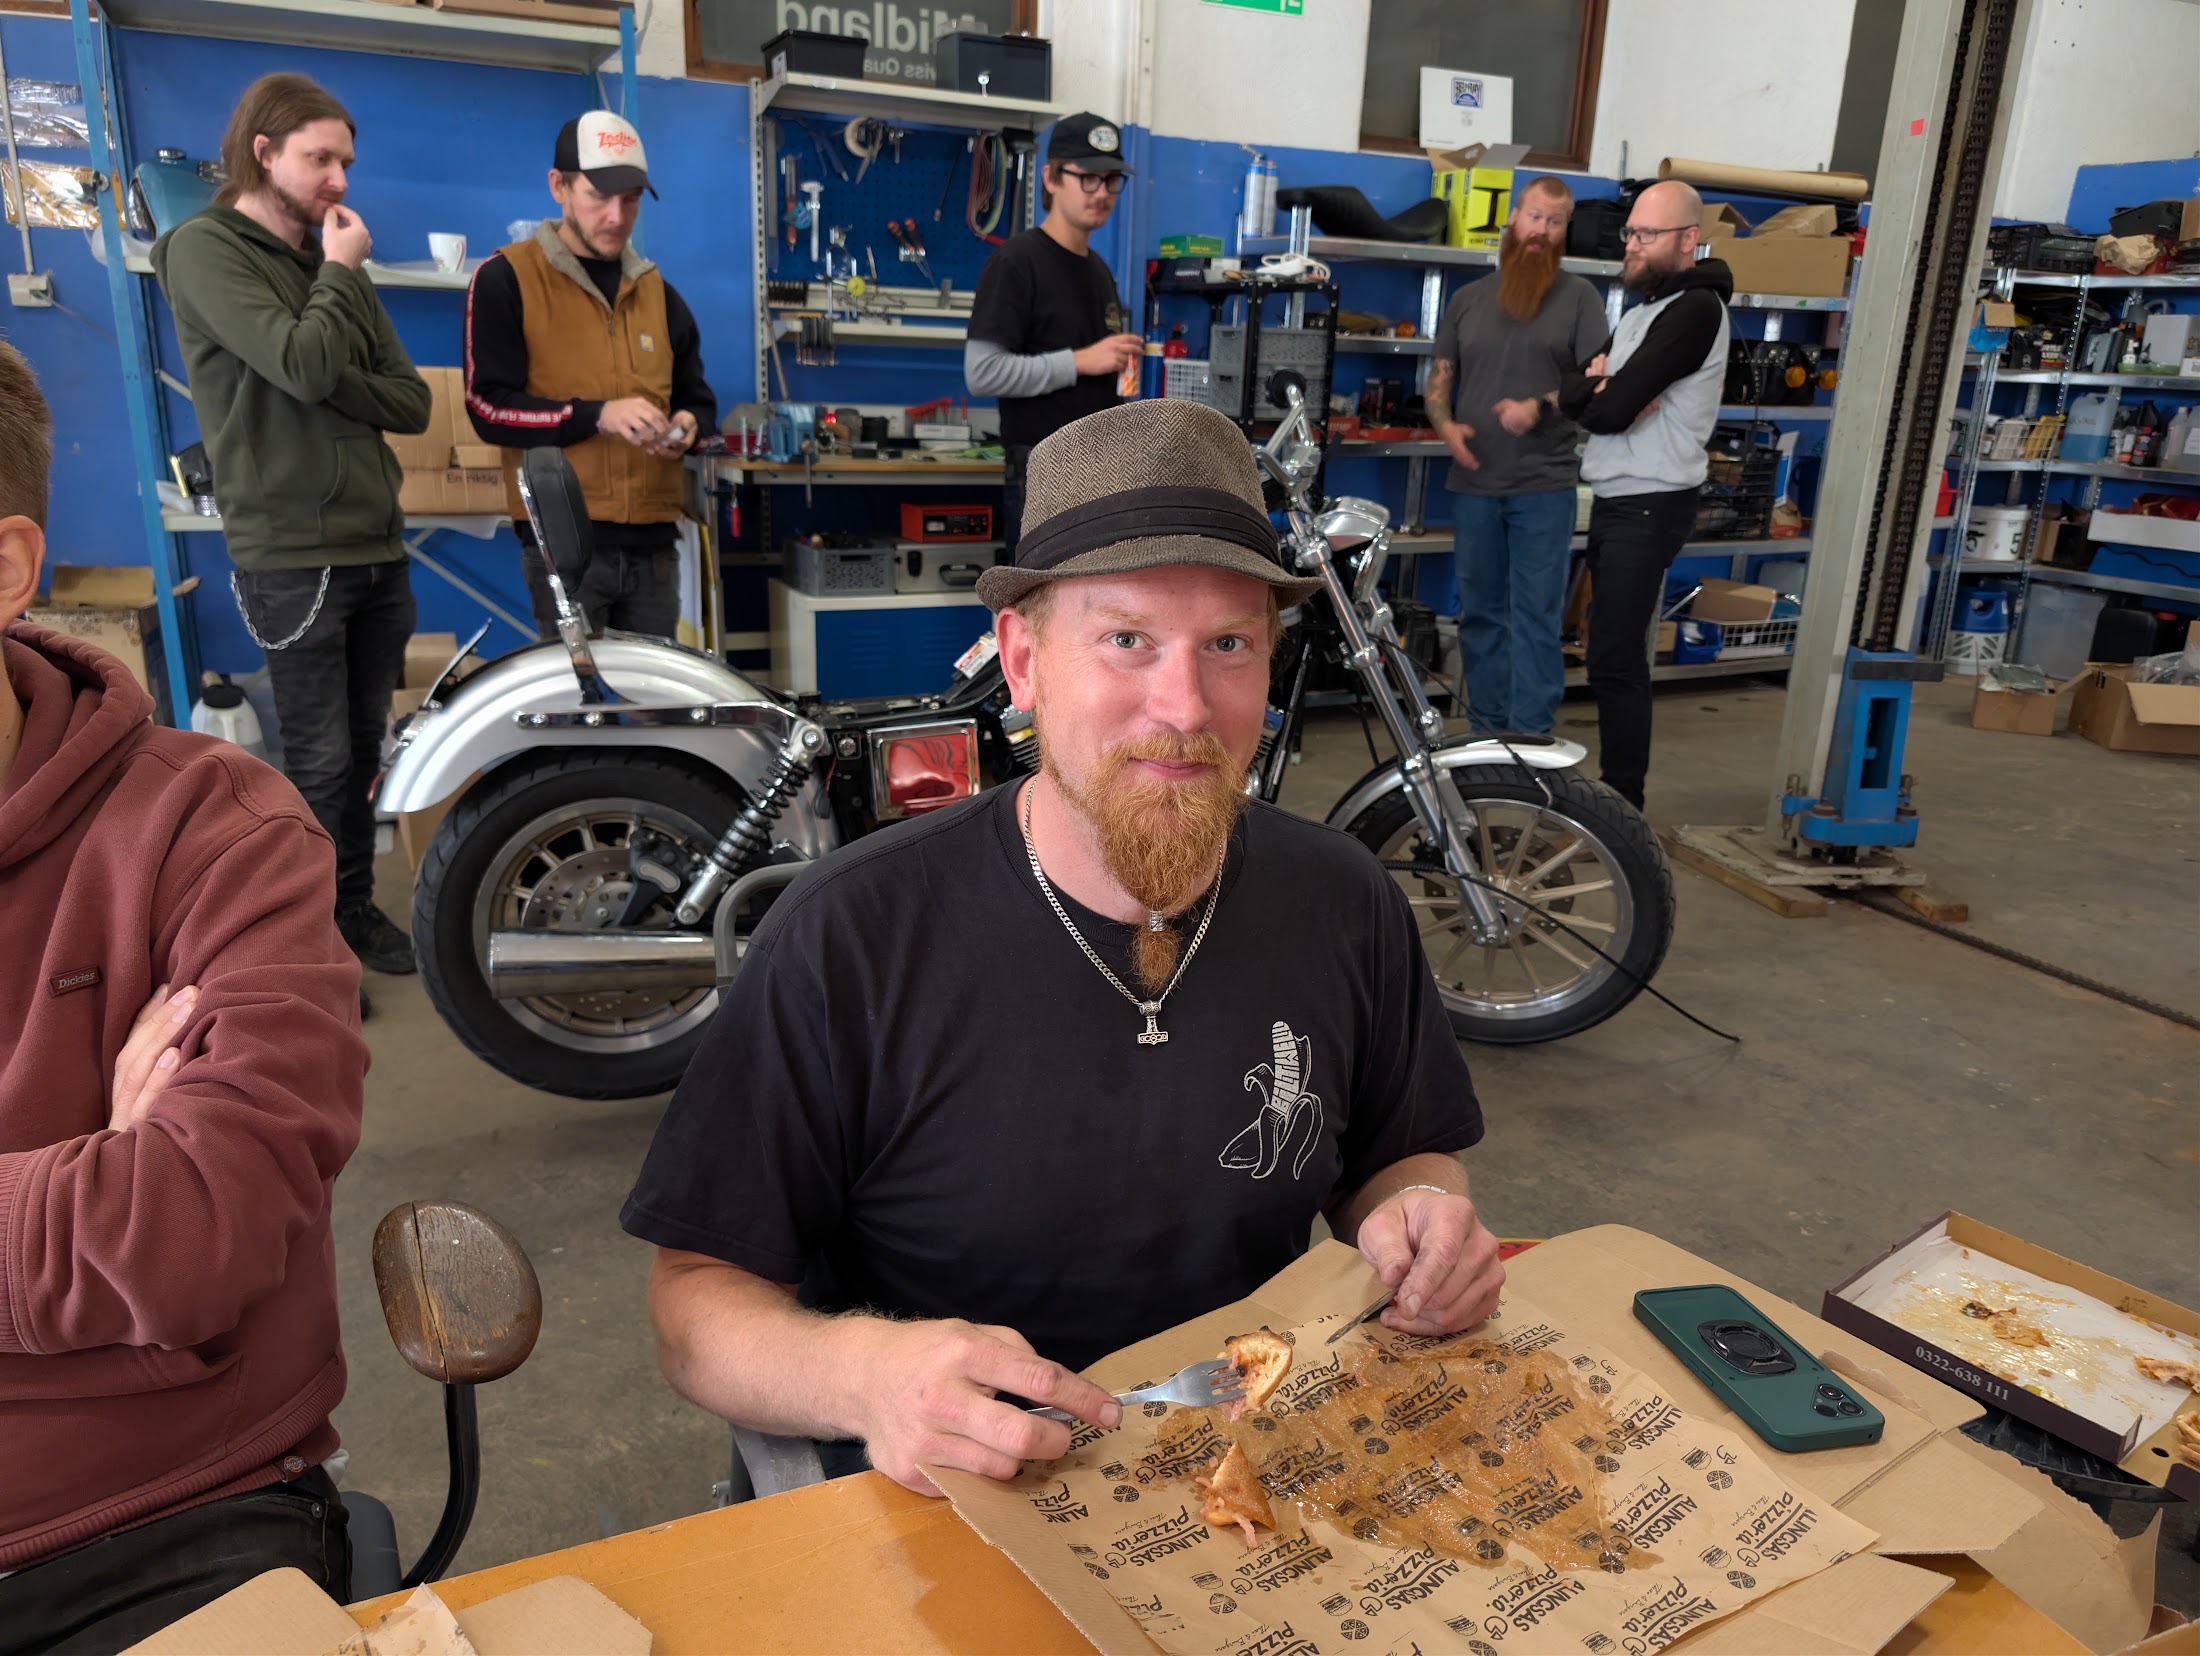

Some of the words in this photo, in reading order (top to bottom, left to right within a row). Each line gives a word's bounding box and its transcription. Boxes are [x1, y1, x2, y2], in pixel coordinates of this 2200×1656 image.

[58, 972, 95, 989] Dickies
[1276, 1351, 1340, 1399] pizzeria
[1915, 1346, 1982, 1387] 0322-638
[1985, 1381, 2009, 1401] 111
[1141, 1415, 1214, 1465] pizzeria
[1606, 1395, 1663, 1439] pizzeria
[1111, 1504, 1190, 1551] pizzeria
[1610, 1475, 1671, 1533] pizzeria
[1633, 1496, 1698, 1549] ALINGSÅS
[1736, 1491, 1793, 1545] pizzeria
[1129, 1526, 1210, 1567] ALINGSÅS
[1235, 1527, 1311, 1577] pizzeria
[1256, 1547, 1334, 1592] ALINGSÅS
[1363, 1541, 1435, 1593] pizzeria
[1385, 1559, 1460, 1610] ALINGSÅS
[1512, 1580, 1586, 1632] ALINGSÅS
[1622, 1575, 1687, 1633] pizzeria
[1648, 1598, 1717, 1649] ALINGSÅS
